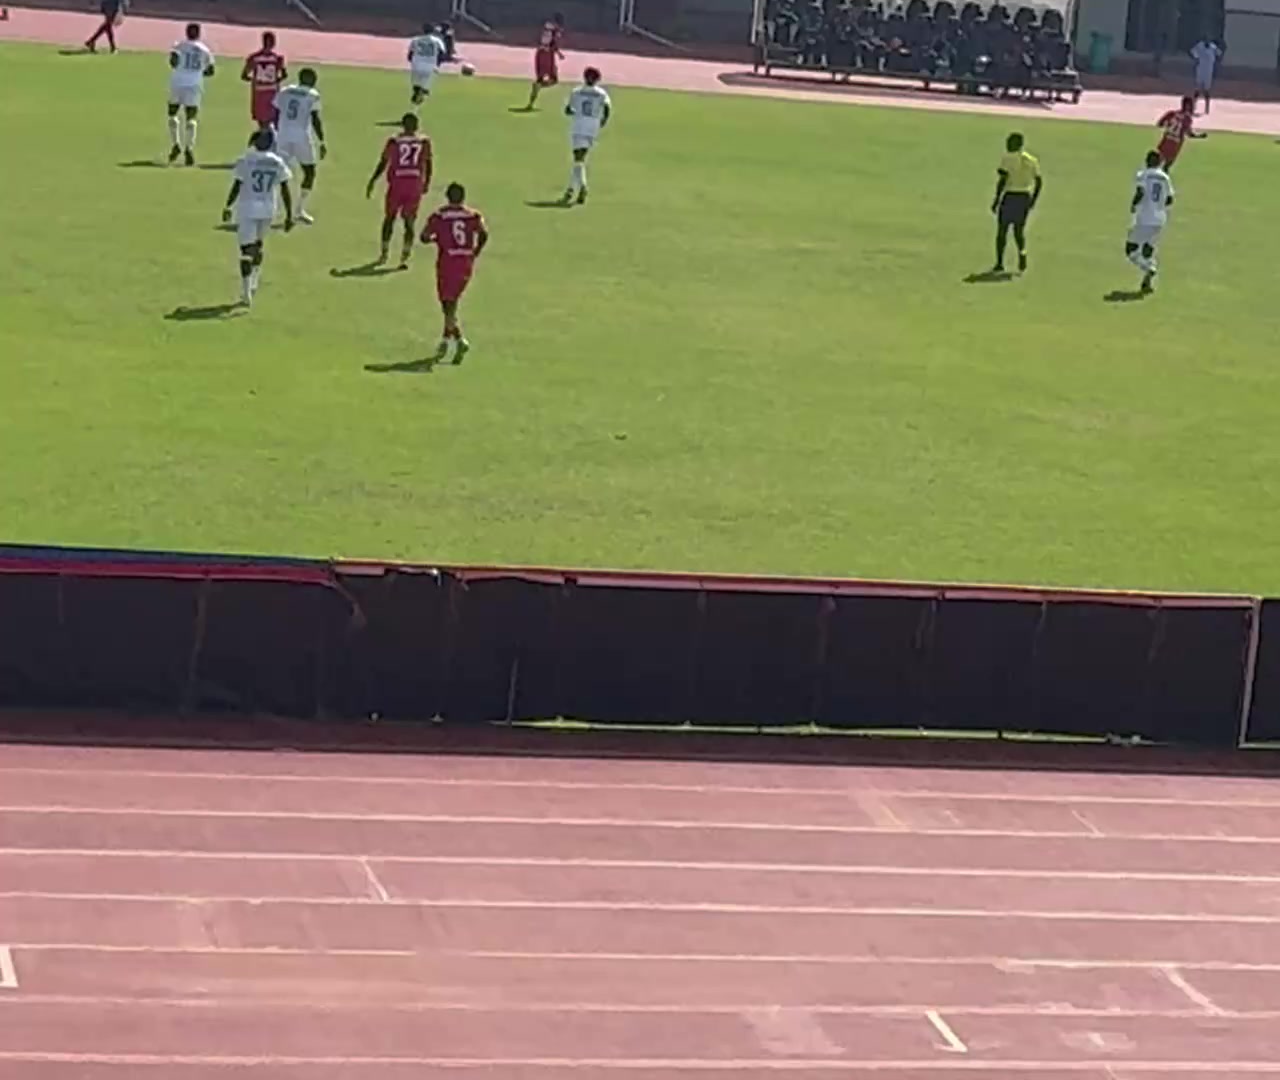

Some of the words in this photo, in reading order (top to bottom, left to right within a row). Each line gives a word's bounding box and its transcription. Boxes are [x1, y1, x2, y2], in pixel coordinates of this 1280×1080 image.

[400, 143, 421, 165] 27
[252, 170, 277, 193] 37
[453, 221, 466, 245] 6
